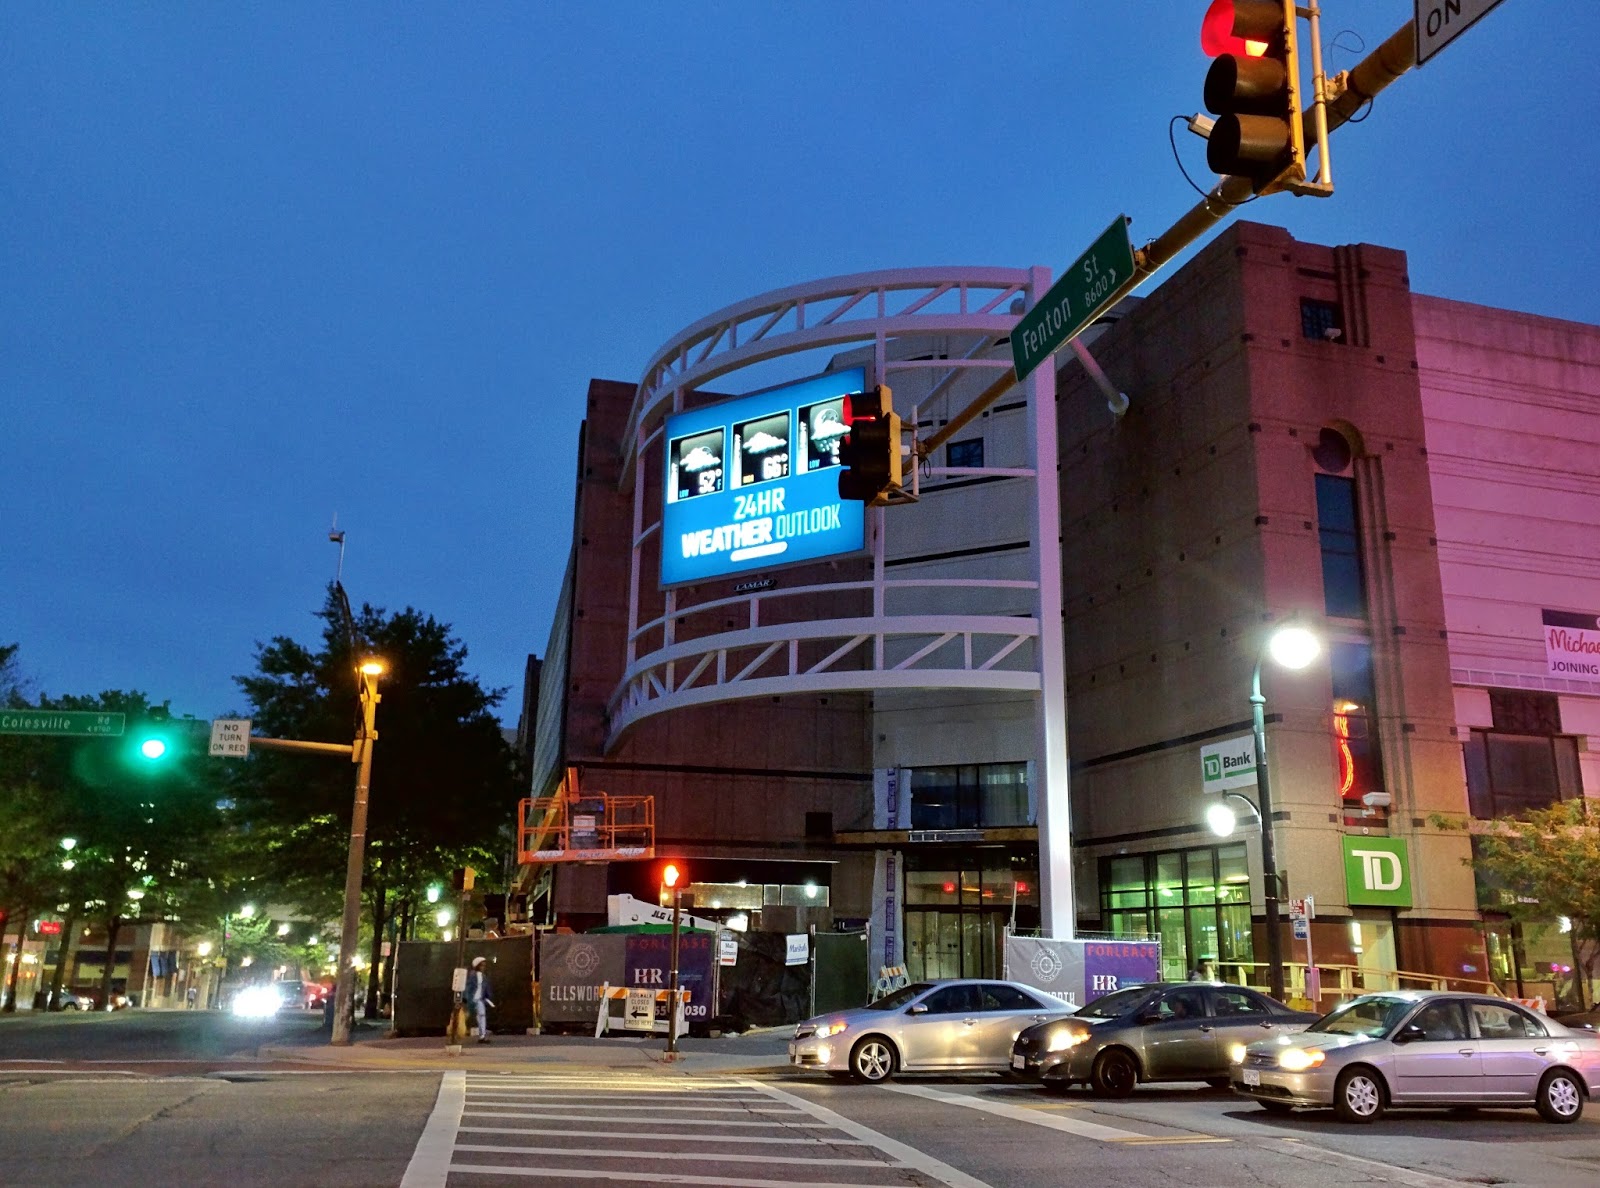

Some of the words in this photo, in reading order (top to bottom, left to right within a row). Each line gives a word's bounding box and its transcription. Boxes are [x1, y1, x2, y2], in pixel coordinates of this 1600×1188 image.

[1427, 0, 1461, 37] ON
[1085, 275, 1108, 308] 8600
[1022, 297, 1071, 360] Fenton
[1083, 253, 1099, 283] St
[809, 458, 820, 469] LOW
[734, 487, 786, 521] 24HR
[681, 516, 773, 558] WEATHER
[776, 503, 842, 540] OUTLOOK
[736, 579, 771, 591] LAMAR
[1552, 661, 1599, 675] JOINING
[2, 715, 71, 730] Colesville
[224, 724, 239, 732] NO
[219, 733, 243, 742] TURN
[212, 743, 224, 751] ON
[228, 744, 246, 752] RED
[1204, 759, 1220, 776] TD
[1223, 751, 1251, 769] Bank
[1351, 849, 1402, 891] TD
[651, 910, 666, 920] JLG
[550, 985, 600, 1001] ELLSWOR
